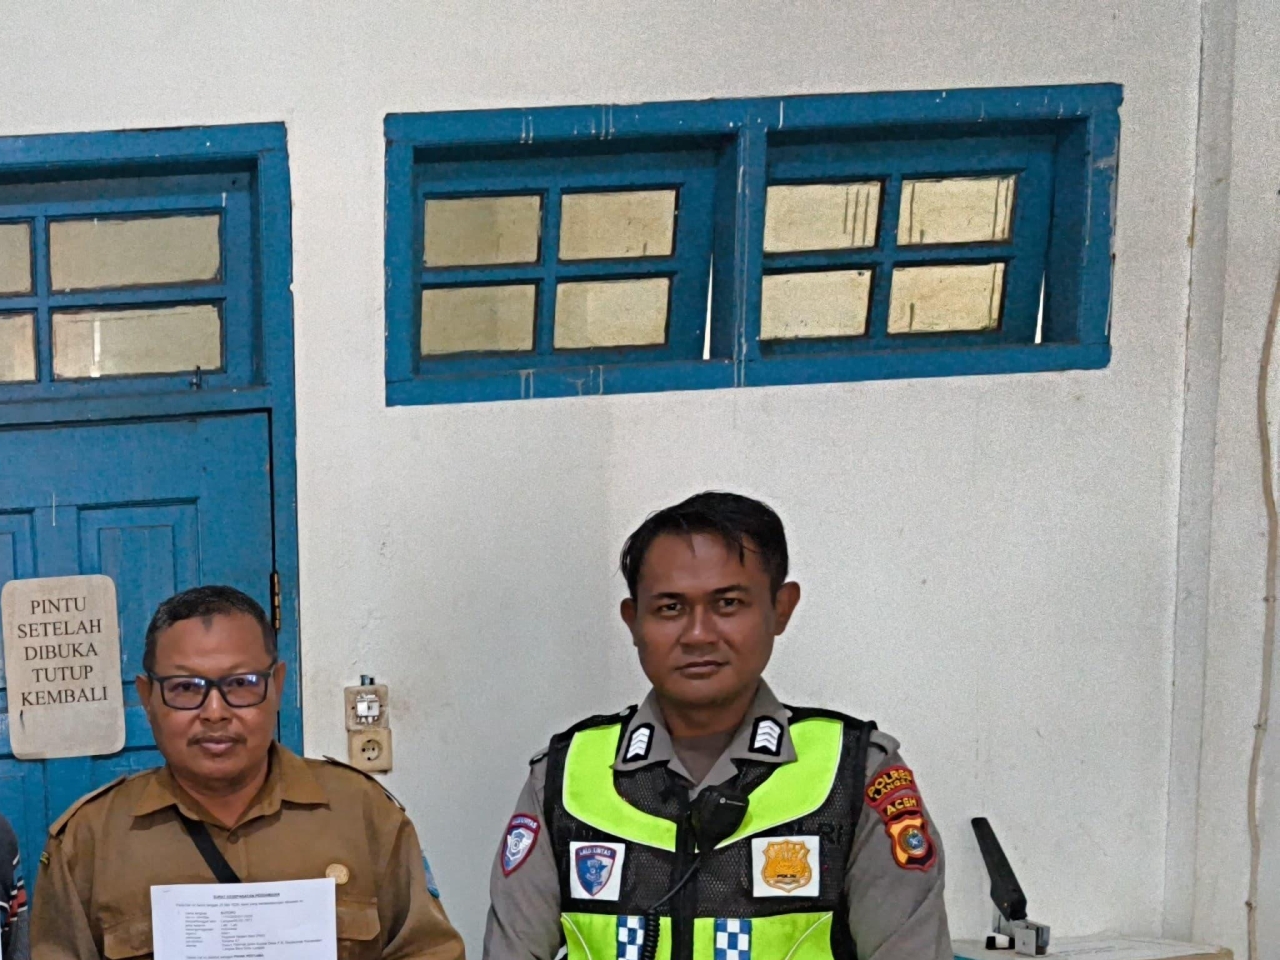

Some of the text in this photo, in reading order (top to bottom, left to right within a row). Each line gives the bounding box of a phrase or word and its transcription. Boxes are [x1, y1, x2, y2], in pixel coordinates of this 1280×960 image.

[31, 597, 86, 615] PINTU
[17, 618, 102, 639] SETELAH
[25, 642, 98, 661] DIBUKA
[32, 665, 93, 683] TUTUP
[21, 686, 108, 707] KEMBALI
[886, 797, 917, 816] ACEH
